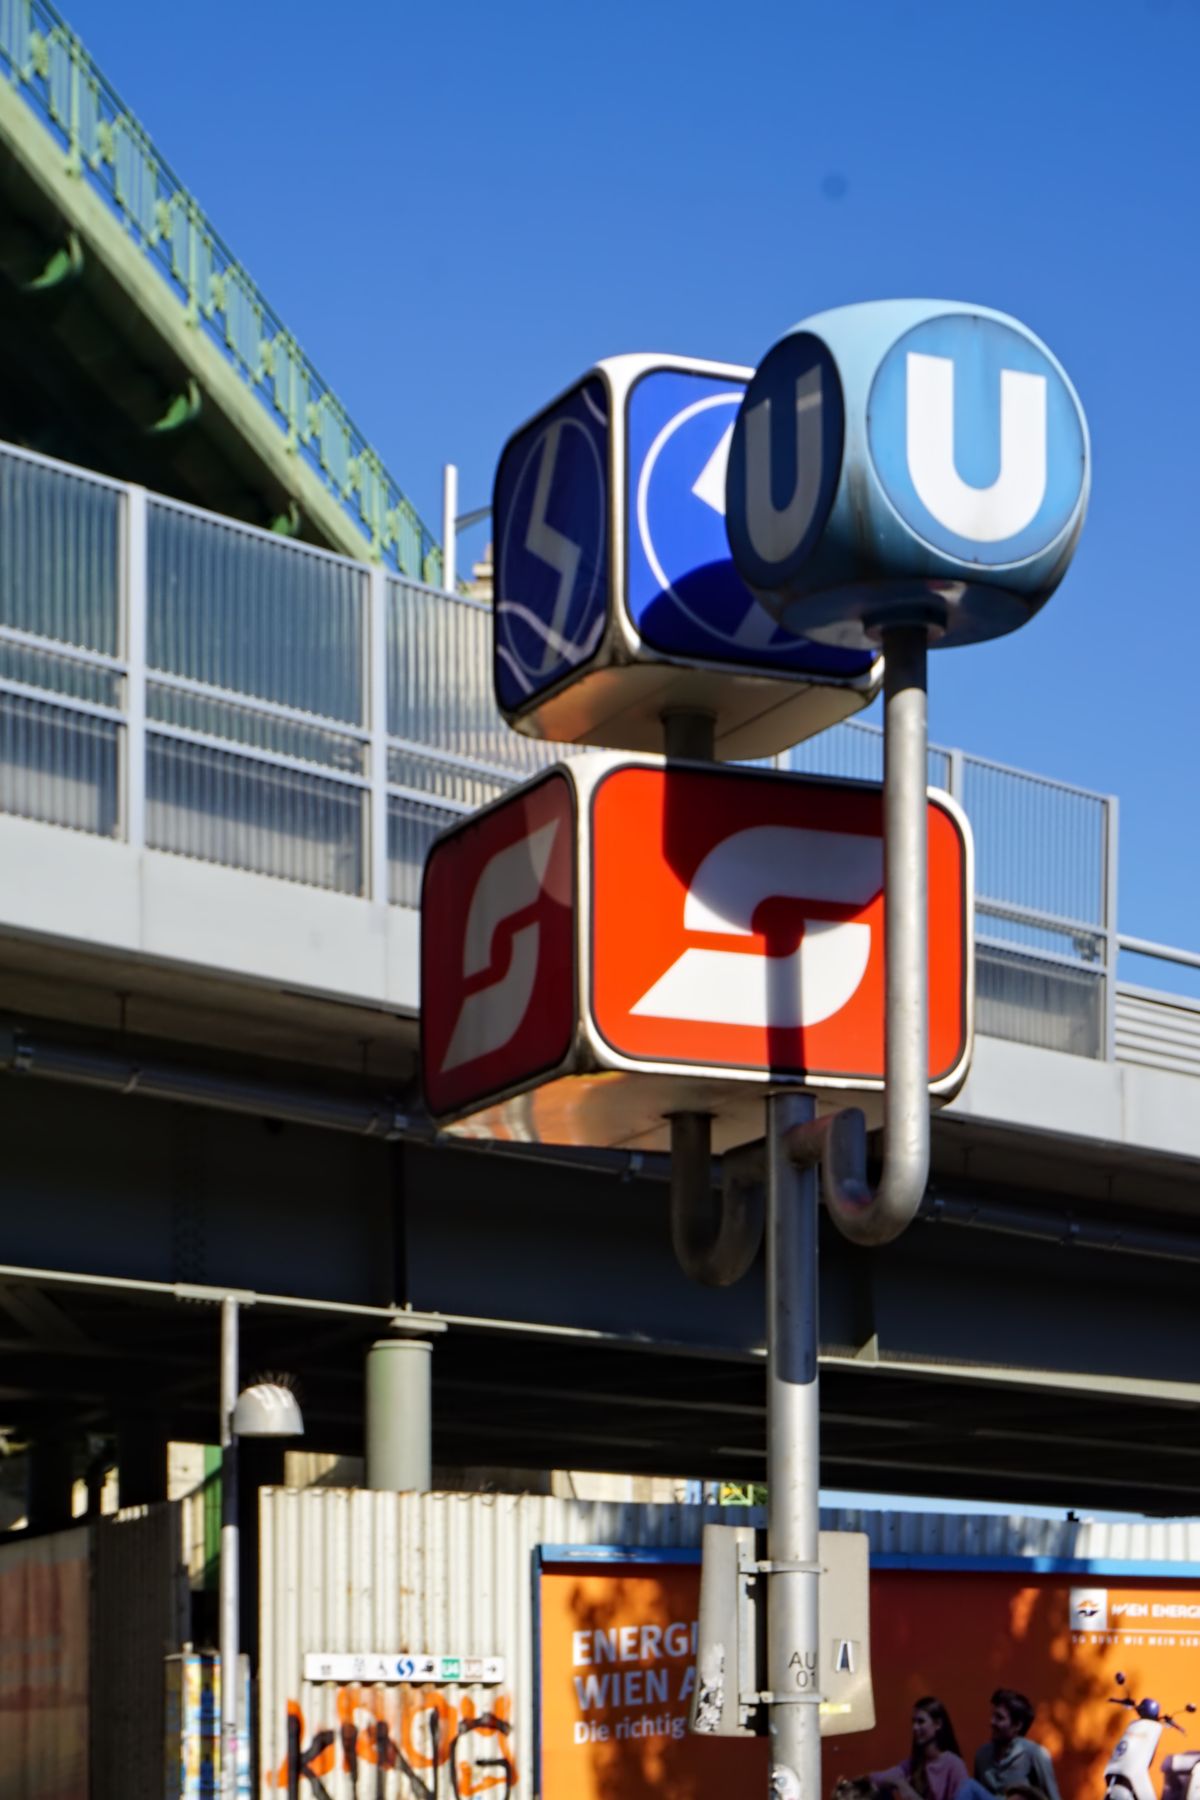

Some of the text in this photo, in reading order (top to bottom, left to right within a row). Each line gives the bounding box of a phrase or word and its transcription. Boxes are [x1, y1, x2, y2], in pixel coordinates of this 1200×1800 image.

[744, 364, 822, 564] U
[906, 351, 1047, 543] U
[1110, 1603, 1148, 1617] WIEN
[573, 1668, 668, 1711] WIEN
[574, 1720, 610, 1745] Die
